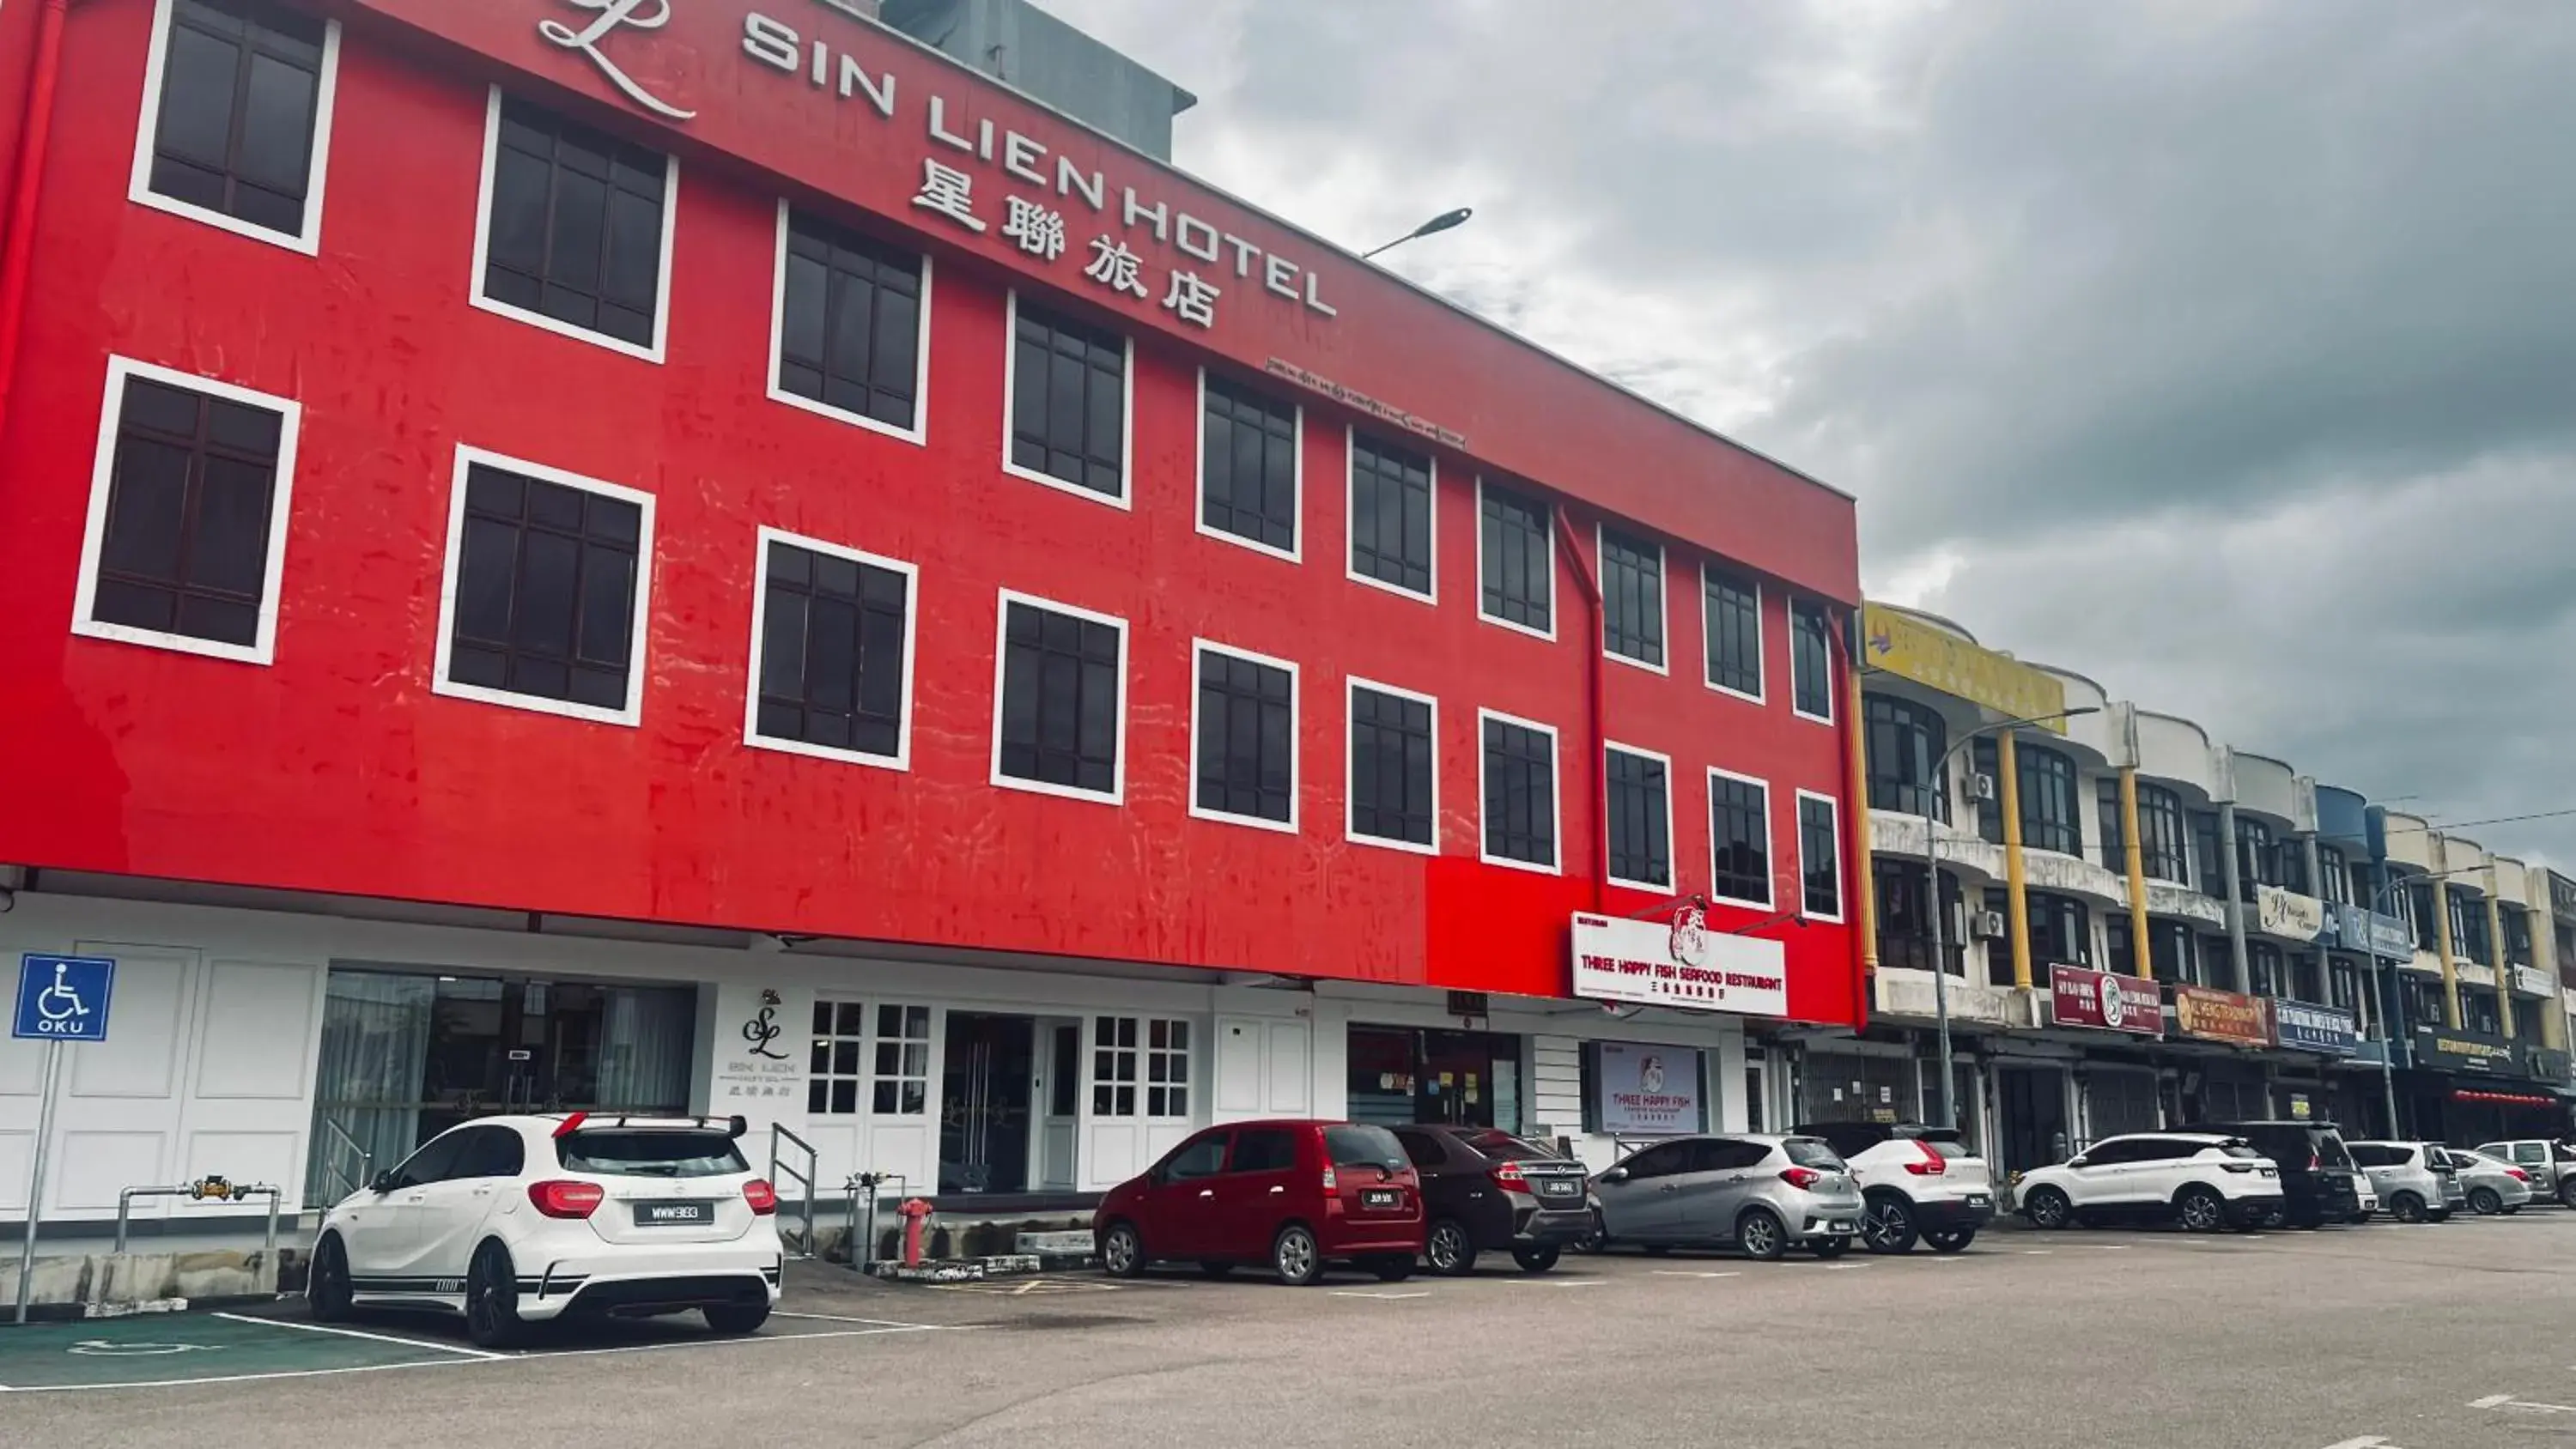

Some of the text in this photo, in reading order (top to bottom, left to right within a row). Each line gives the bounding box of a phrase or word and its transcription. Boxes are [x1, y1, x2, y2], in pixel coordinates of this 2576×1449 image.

[742, 12, 1337, 317] SIN LIEN HOTEL
[912, 158, 1221, 328] 星聯旅店
[1581, 955, 1615, 973] THREE
[1618, 959, 1651, 976] HAPPY
[1655, 963, 1676, 979] FISH
[1680, 967, 1722, 985] SEAFOOD
[1725, 972, 1783, 991] RESTAURANT
[38, 1020, 83, 1034] OKU
[1613, 1093, 1641, 1106] THREE
[1643, 1094, 1670, 1106] HAPPY
